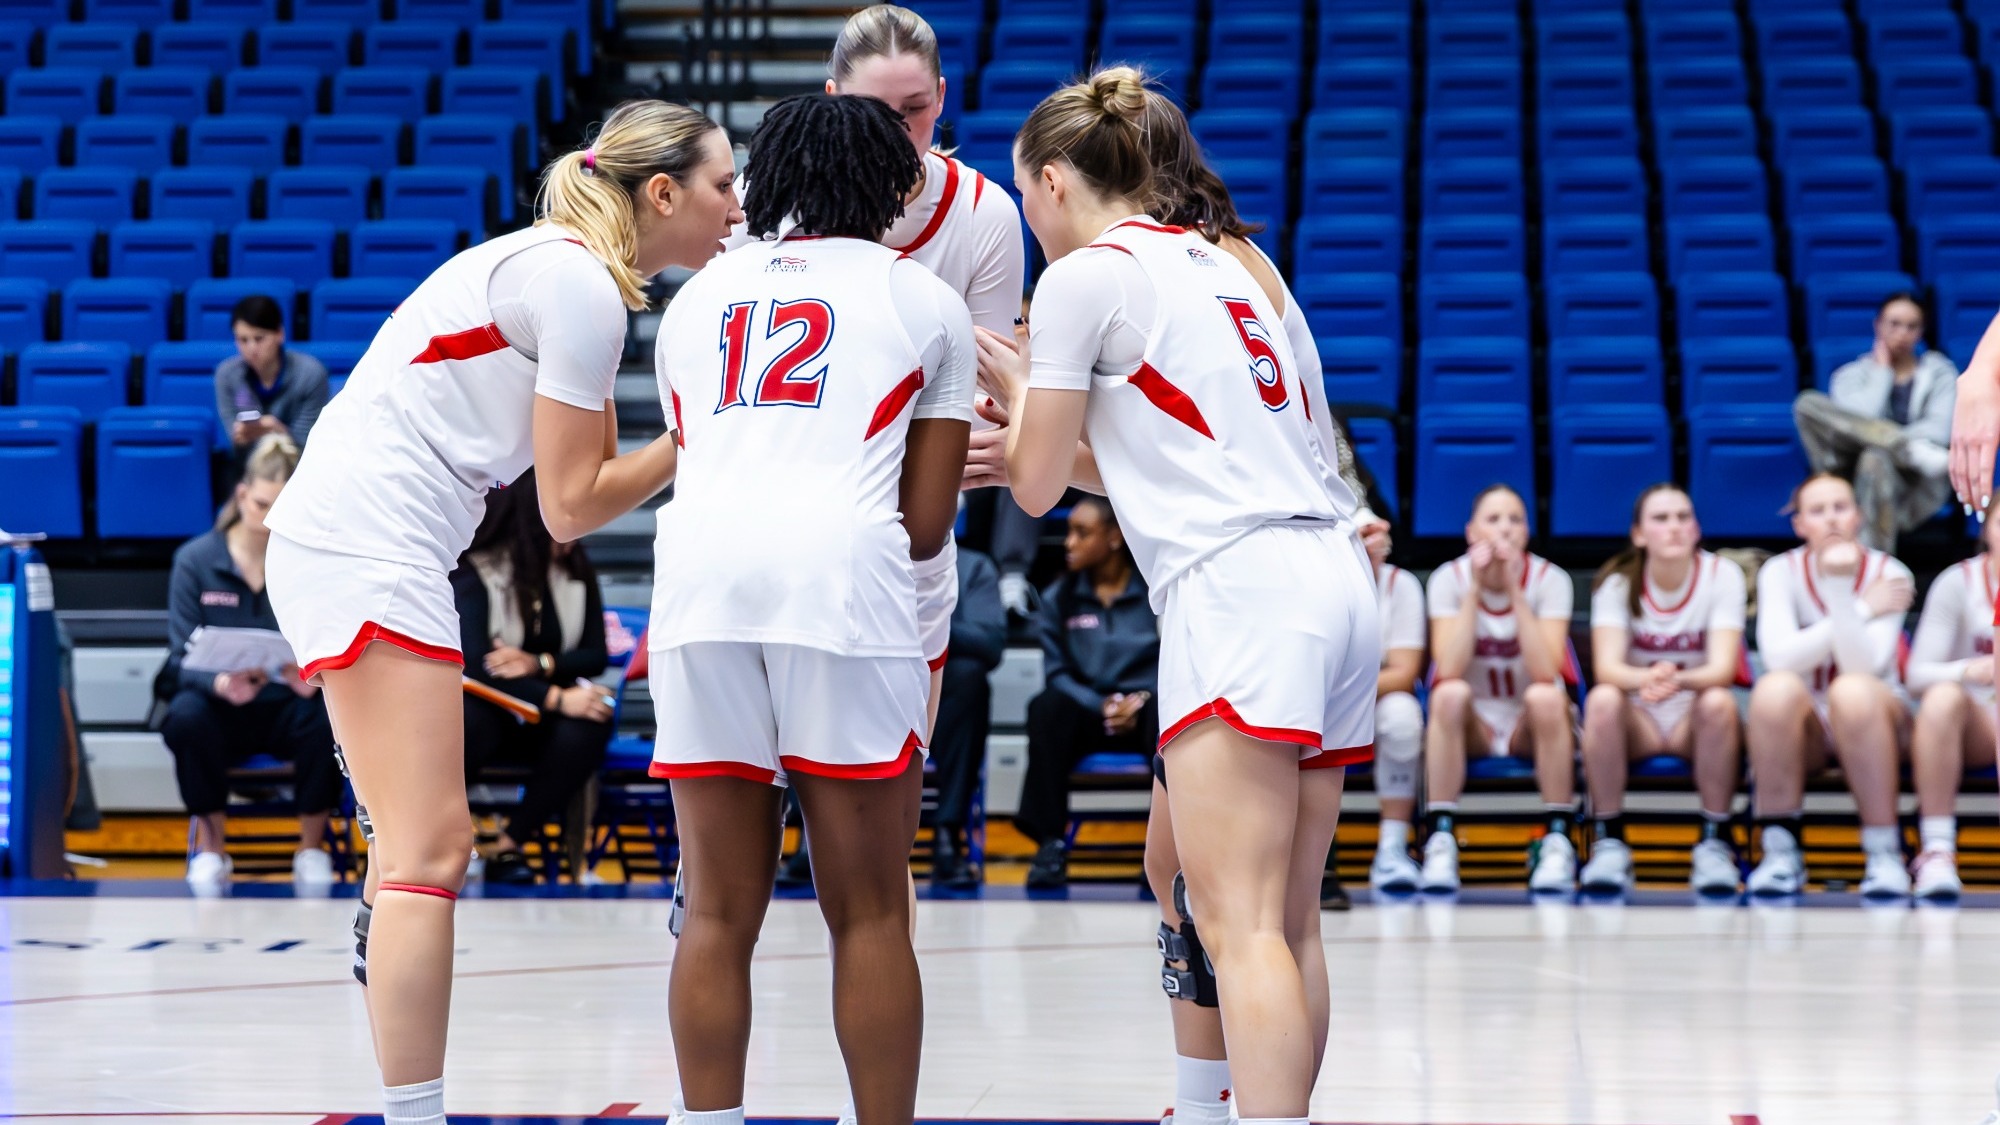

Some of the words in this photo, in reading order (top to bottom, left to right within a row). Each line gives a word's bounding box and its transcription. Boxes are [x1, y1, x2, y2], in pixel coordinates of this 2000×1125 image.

[713, 298, 835, 415] 12
[1215, 295, 1290, 412] 5
[1488, 667, 1515, 698] 11
